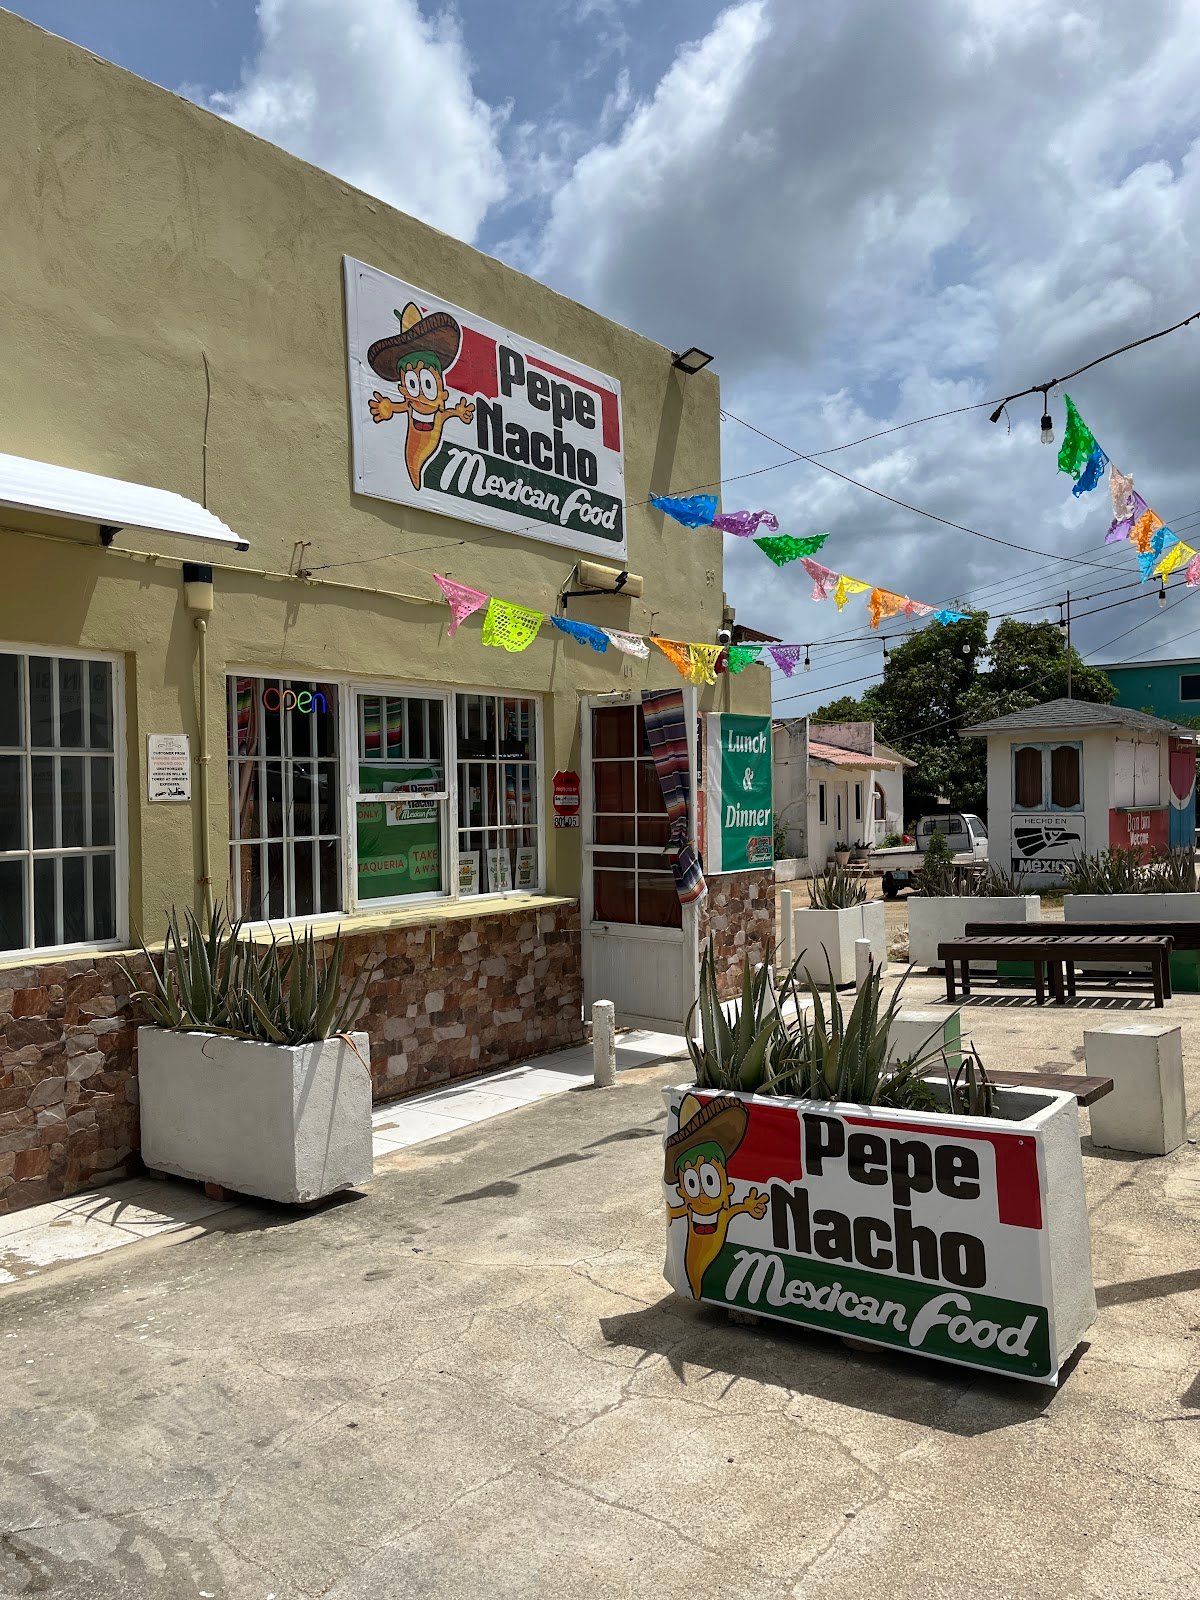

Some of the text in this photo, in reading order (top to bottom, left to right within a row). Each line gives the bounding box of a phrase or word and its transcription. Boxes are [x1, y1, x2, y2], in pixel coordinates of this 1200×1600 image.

[499, 345, 596, 430] Pepe
[476, 397, 598, 487] Nacho
[439, 447, 619, 530] Mexican Food
[727, 729, 767, 754] Lunch
[742, 767, 754, 791] &
[412, 849, 438, 861] TAKE
[725, 802, 771, 828] Dinner
[357, 859, 404, 872] TAQUERIA
[801, 1113, 981, 1207] Pepe
[770, 1184, 987, 1288] Nacho
[724, 1249, 1038, 1357] Mexican Food
